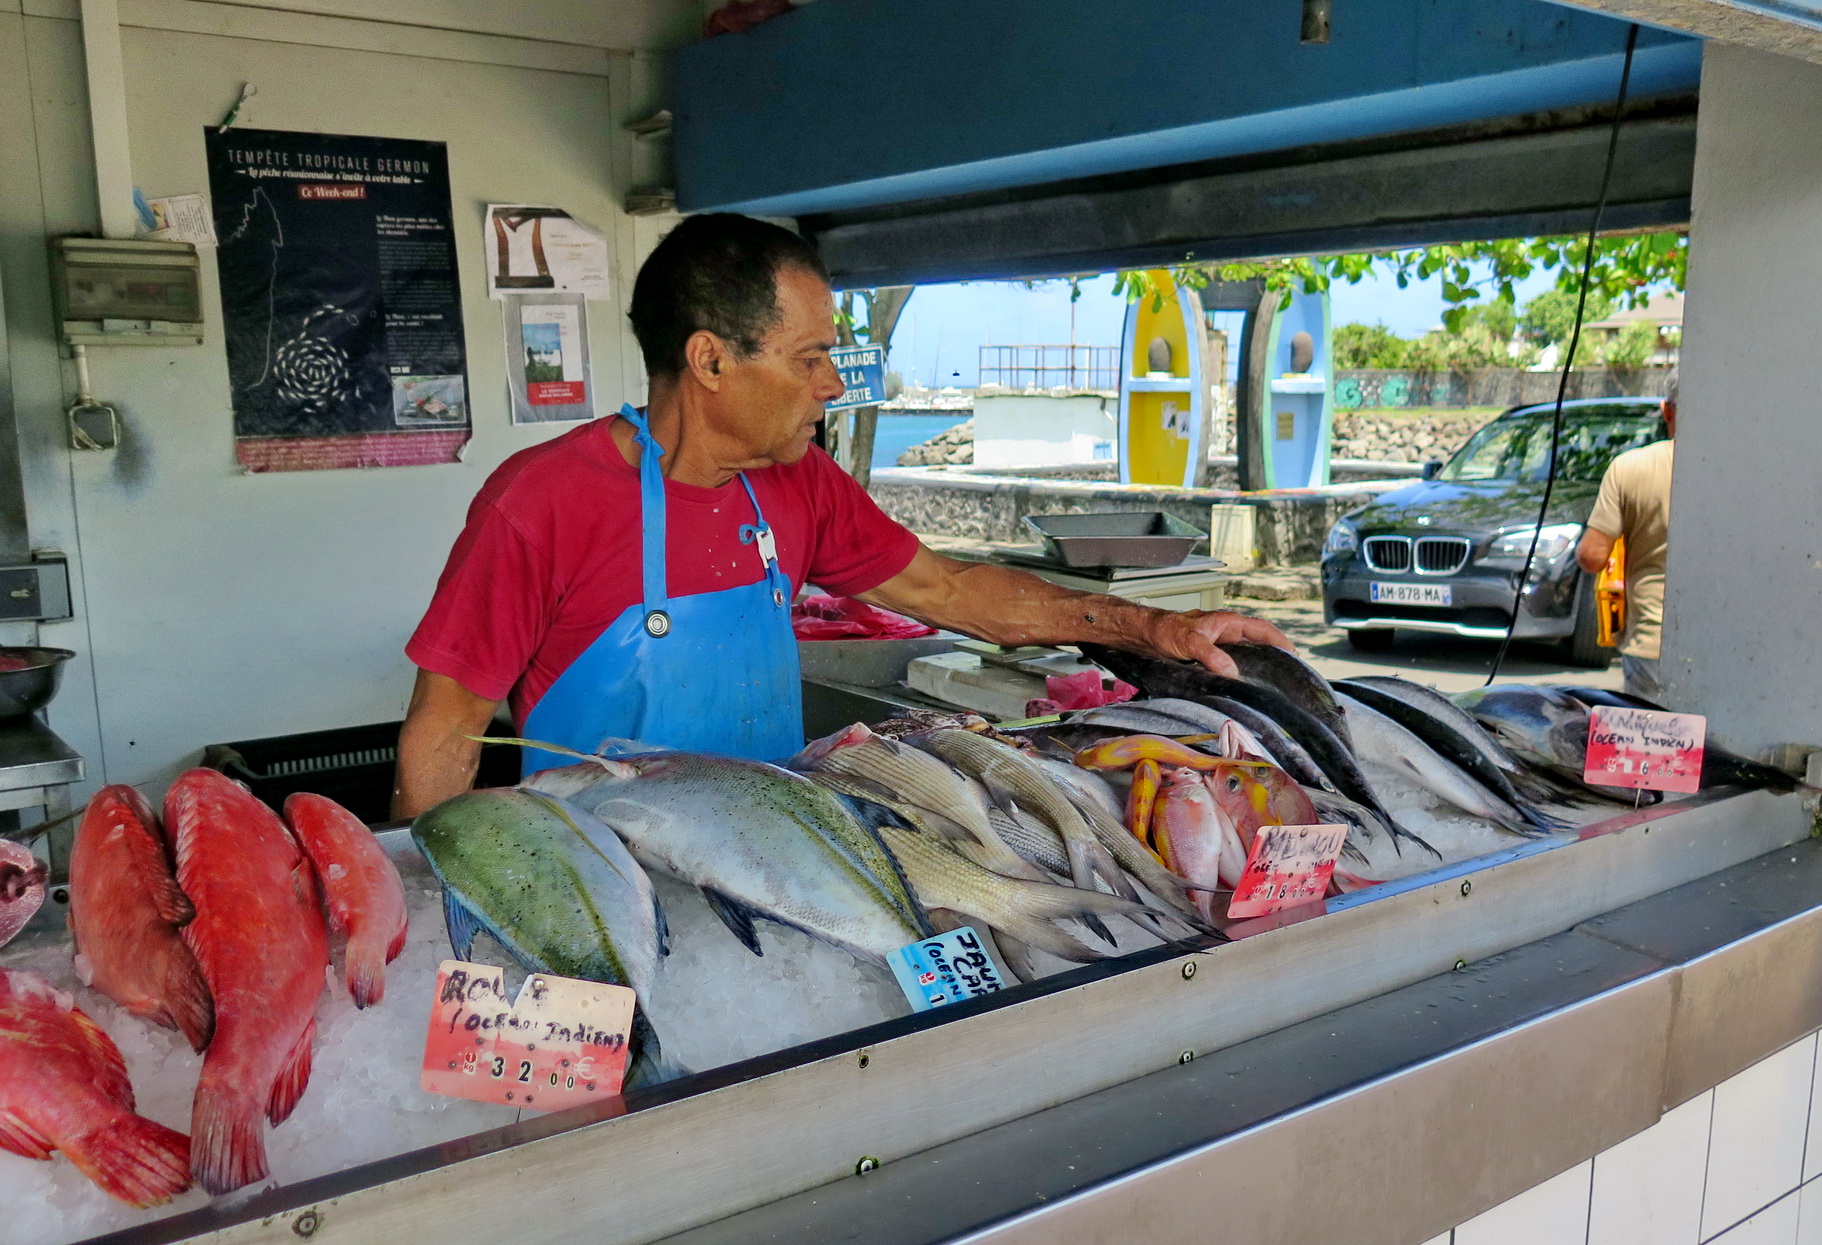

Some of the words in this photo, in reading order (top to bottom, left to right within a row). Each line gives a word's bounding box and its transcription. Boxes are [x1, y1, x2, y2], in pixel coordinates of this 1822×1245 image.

[228, 149, 289, 166] TEMPÊTE
[297, 153, 369, 171] TROPICALE
[377, 157, 430, 174] GERMON
[301, 186, 312, 198] Ce
[314, 185, 358, 198] Week-end
[851, 371, 865, 385] LA
[930, 994, 945, 1004] 1
[463, 1062, 475, 1073] kg
